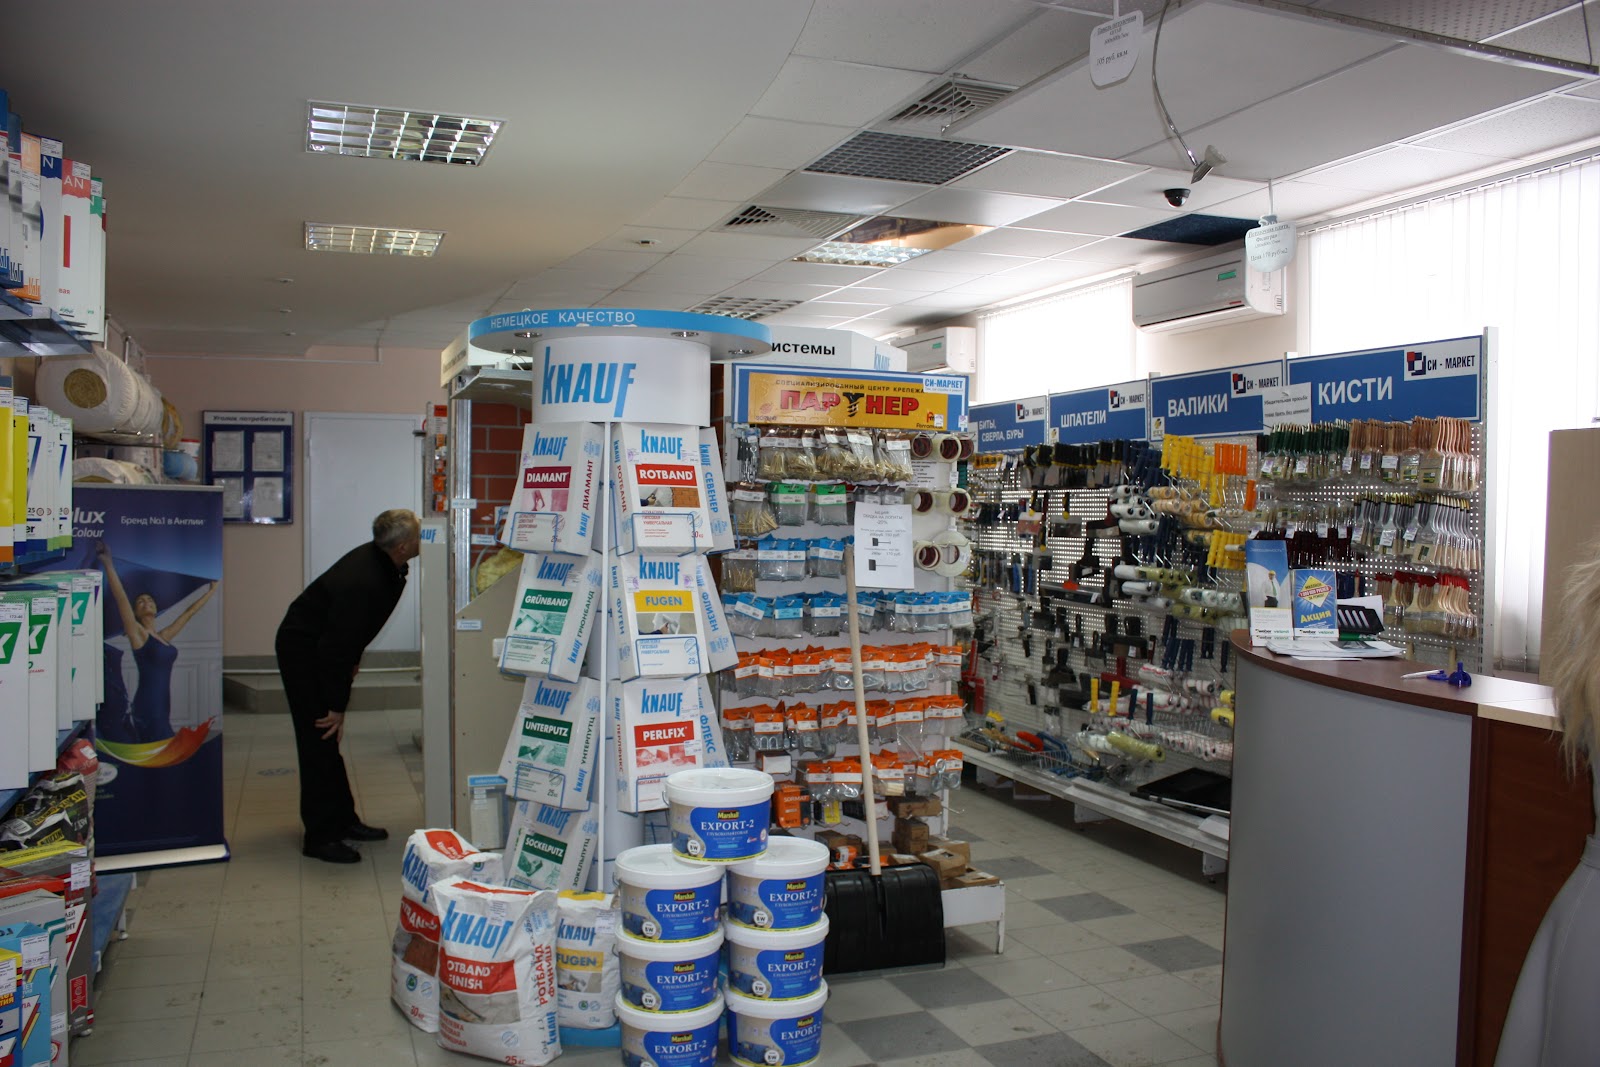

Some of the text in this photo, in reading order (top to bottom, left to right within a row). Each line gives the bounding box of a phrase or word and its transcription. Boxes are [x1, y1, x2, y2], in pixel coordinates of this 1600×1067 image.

[490, 311, 635, 329] НЕМЕЦКОЕ КАЧЕСТВО
[771, 341, 836, 356] истемы
[1427, 359, 1437, 371] СИ
[1445, 355, 1476, 369] МАРКЕТ
[541, 346, 637, 418] KNAUF
[775, 379, 925, 395] СПЕЦИАЛИЗИРОВАННЫЙ ЦЕНТР КРЕПЕЖА
[925, 378, 963, 389] СИ-МАРКЕТ
[1246, 379, 1253, 390] СИ
[1258, 376, 1279, 388] МАРКЕТ
[1129, 393, 1145, 404] МАРКЕТ
[1318, 376, 1393, 406] КИСТИ
[1168, 393, 1228, 418] ВАЛИКИ
[978, 419, 997, 430] БИТЫ,
[1060, 409, 1107, 428] ШПАТЕЛИ
[981, 428, 1024, 442] СВЕРЛА, БУРЫ
[532, 431, 568, 461] KNAUF
[641, 429, 683, 460] KNAUF
[699, 443, 711, 466] KNAUF
[526, 472, 567, 483] DIAMANT
[639, 469, 693, 480] ROTBAND
[583, 460, 594, 511] ДИАМАНТ
[617, 465, 627, 513] РОТБАНД
[705, 471, 719, 514] СЕВЕНЕР
[73, 507, 106, 524] lux
[120, 515, 148, 526] Бренд
[72, 527, 104, 538] Colour
[576, 512, 591, 537] KNAUF
[420, 528, 437, 543] AUF
[537, 556, 574, 586] KNAUF
[639, 554, 680, 586] KNAUF
[525, 595, 568, 607] GRÜNBAND
[645, 596, 683, 606] FUGEN
[577, 590, 595, 637] ГРЮНБАНД
[702, 592, 719, 632] ФЛИЗЕН
[567, 640, 583, 664] KNAUF
[534, 680, 572, 715] KNAUF
[641, 688, 683, 717] KNAUF
[525, 721, 569, 737] UNTERPUTZ
[643, 727, 686, 741] PERLFIX
[700, 714, 716, 754] ФЛЕКС
[581, 717, 596, 765] УНТЕРПУТЦ
[536, 803, 571, 836] KNAUF
[717, 811, 739, 819] Marshall
[701, 819, 754, 831] EXPORT-2
[525, 837, 564, 858] SOCKELPUTZ
[786, 882, 806, 890] Marshall
[674, 892, 695, 901] Marshall
[769, 889, 818, 902] EXPORT-2
[657, 899, 710, 912] EXPORT-2
[441, 900, 514, 959] KNAUF
[557, 918, 596, 946] KNAUF
[556, 953, 597, 967] FUGEN
[768, 958, 816, 972] EXPORT-2
[784, 953, 805, 961] Marshall
[447, 960, 491, 976] OTBAND
[535, 944, 548, 1005] РОТБАНД
[545, 945, 555, 998] ФИНИШ
[674, 963, 695, 972] Marshall
[449, 974, 483, 990] FINISH
[657, 970, 709, 984] EXPORT-2
[410, 1005, 418, 1016] 30
[547, 1011, 557, 1045] KNAUF
[797, 1017, 814, 1027] Marshall
[671, 1034, 693, 1043] Marshall
[654, 1040, 707, 1054] EXPORT-2
[505, 1055, 517, 1065] 25
